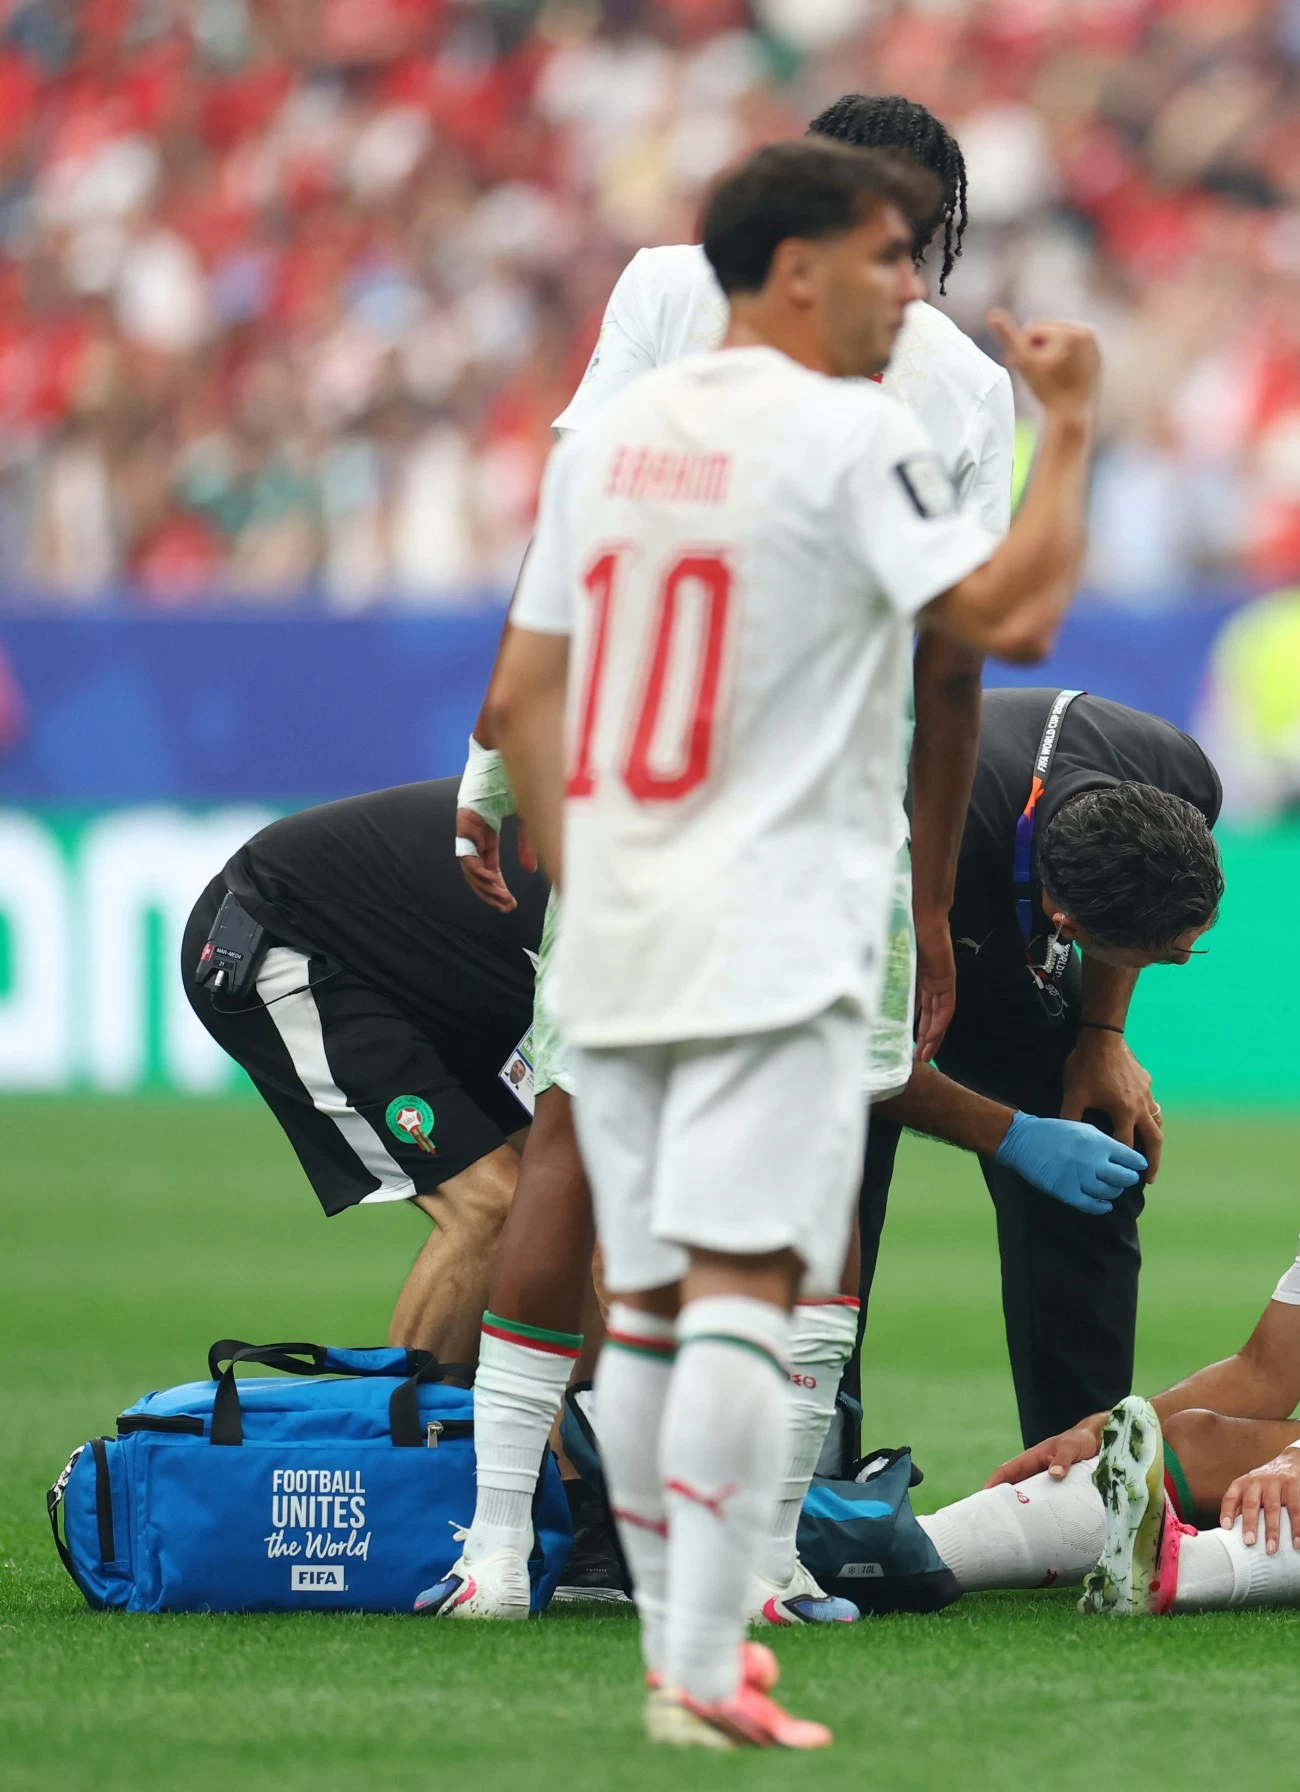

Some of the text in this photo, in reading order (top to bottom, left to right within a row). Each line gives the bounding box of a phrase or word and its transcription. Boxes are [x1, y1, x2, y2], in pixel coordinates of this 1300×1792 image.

[566, 547, 735, 803] 10
[1047, 714, 1060, 729] CUP
[1040, 728, 1056, 756] WORLD
[1037, 755, 1050, 773] FIFA
[273, 1469, 366, 1493] FOOTBALL
[272, 1495, 366, 1529] UNITES
[264, 1529, 371, 1561] the World
[298, 1571, 338, 1585] FIFA
[862, 1565, 875, 1574] 10L
